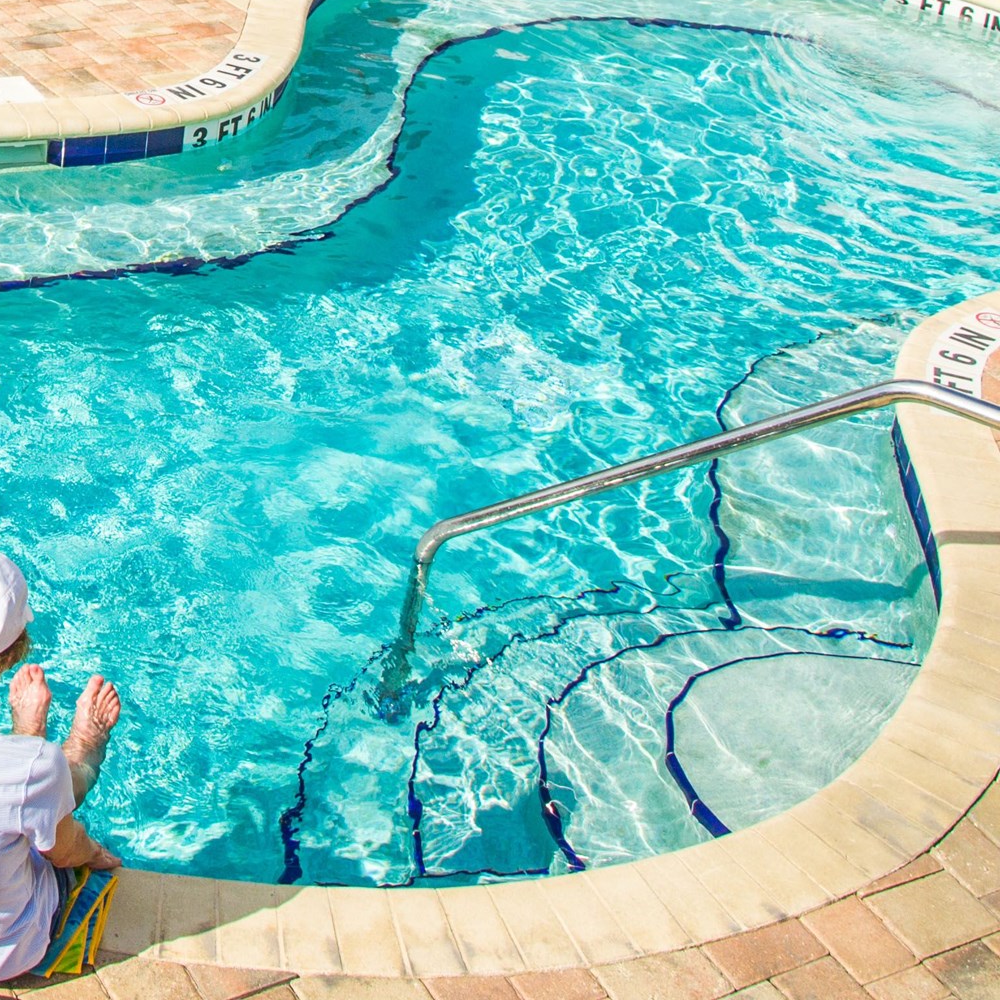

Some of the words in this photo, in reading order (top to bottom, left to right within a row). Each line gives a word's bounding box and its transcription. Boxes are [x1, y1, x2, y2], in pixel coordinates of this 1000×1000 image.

[960, 6, 974, 22] 6
[233, 54, 261, 63] 3
[217, 63, 253, 80] FT
[199, 78, 227, 89] 6
[166, 84, 207, 100] IN
[192, 127, 208, 148] 3
[218, 115, 243, 142] FT
[949, 327, 996, 351] IN
[939, 349, 977, 365] 6
